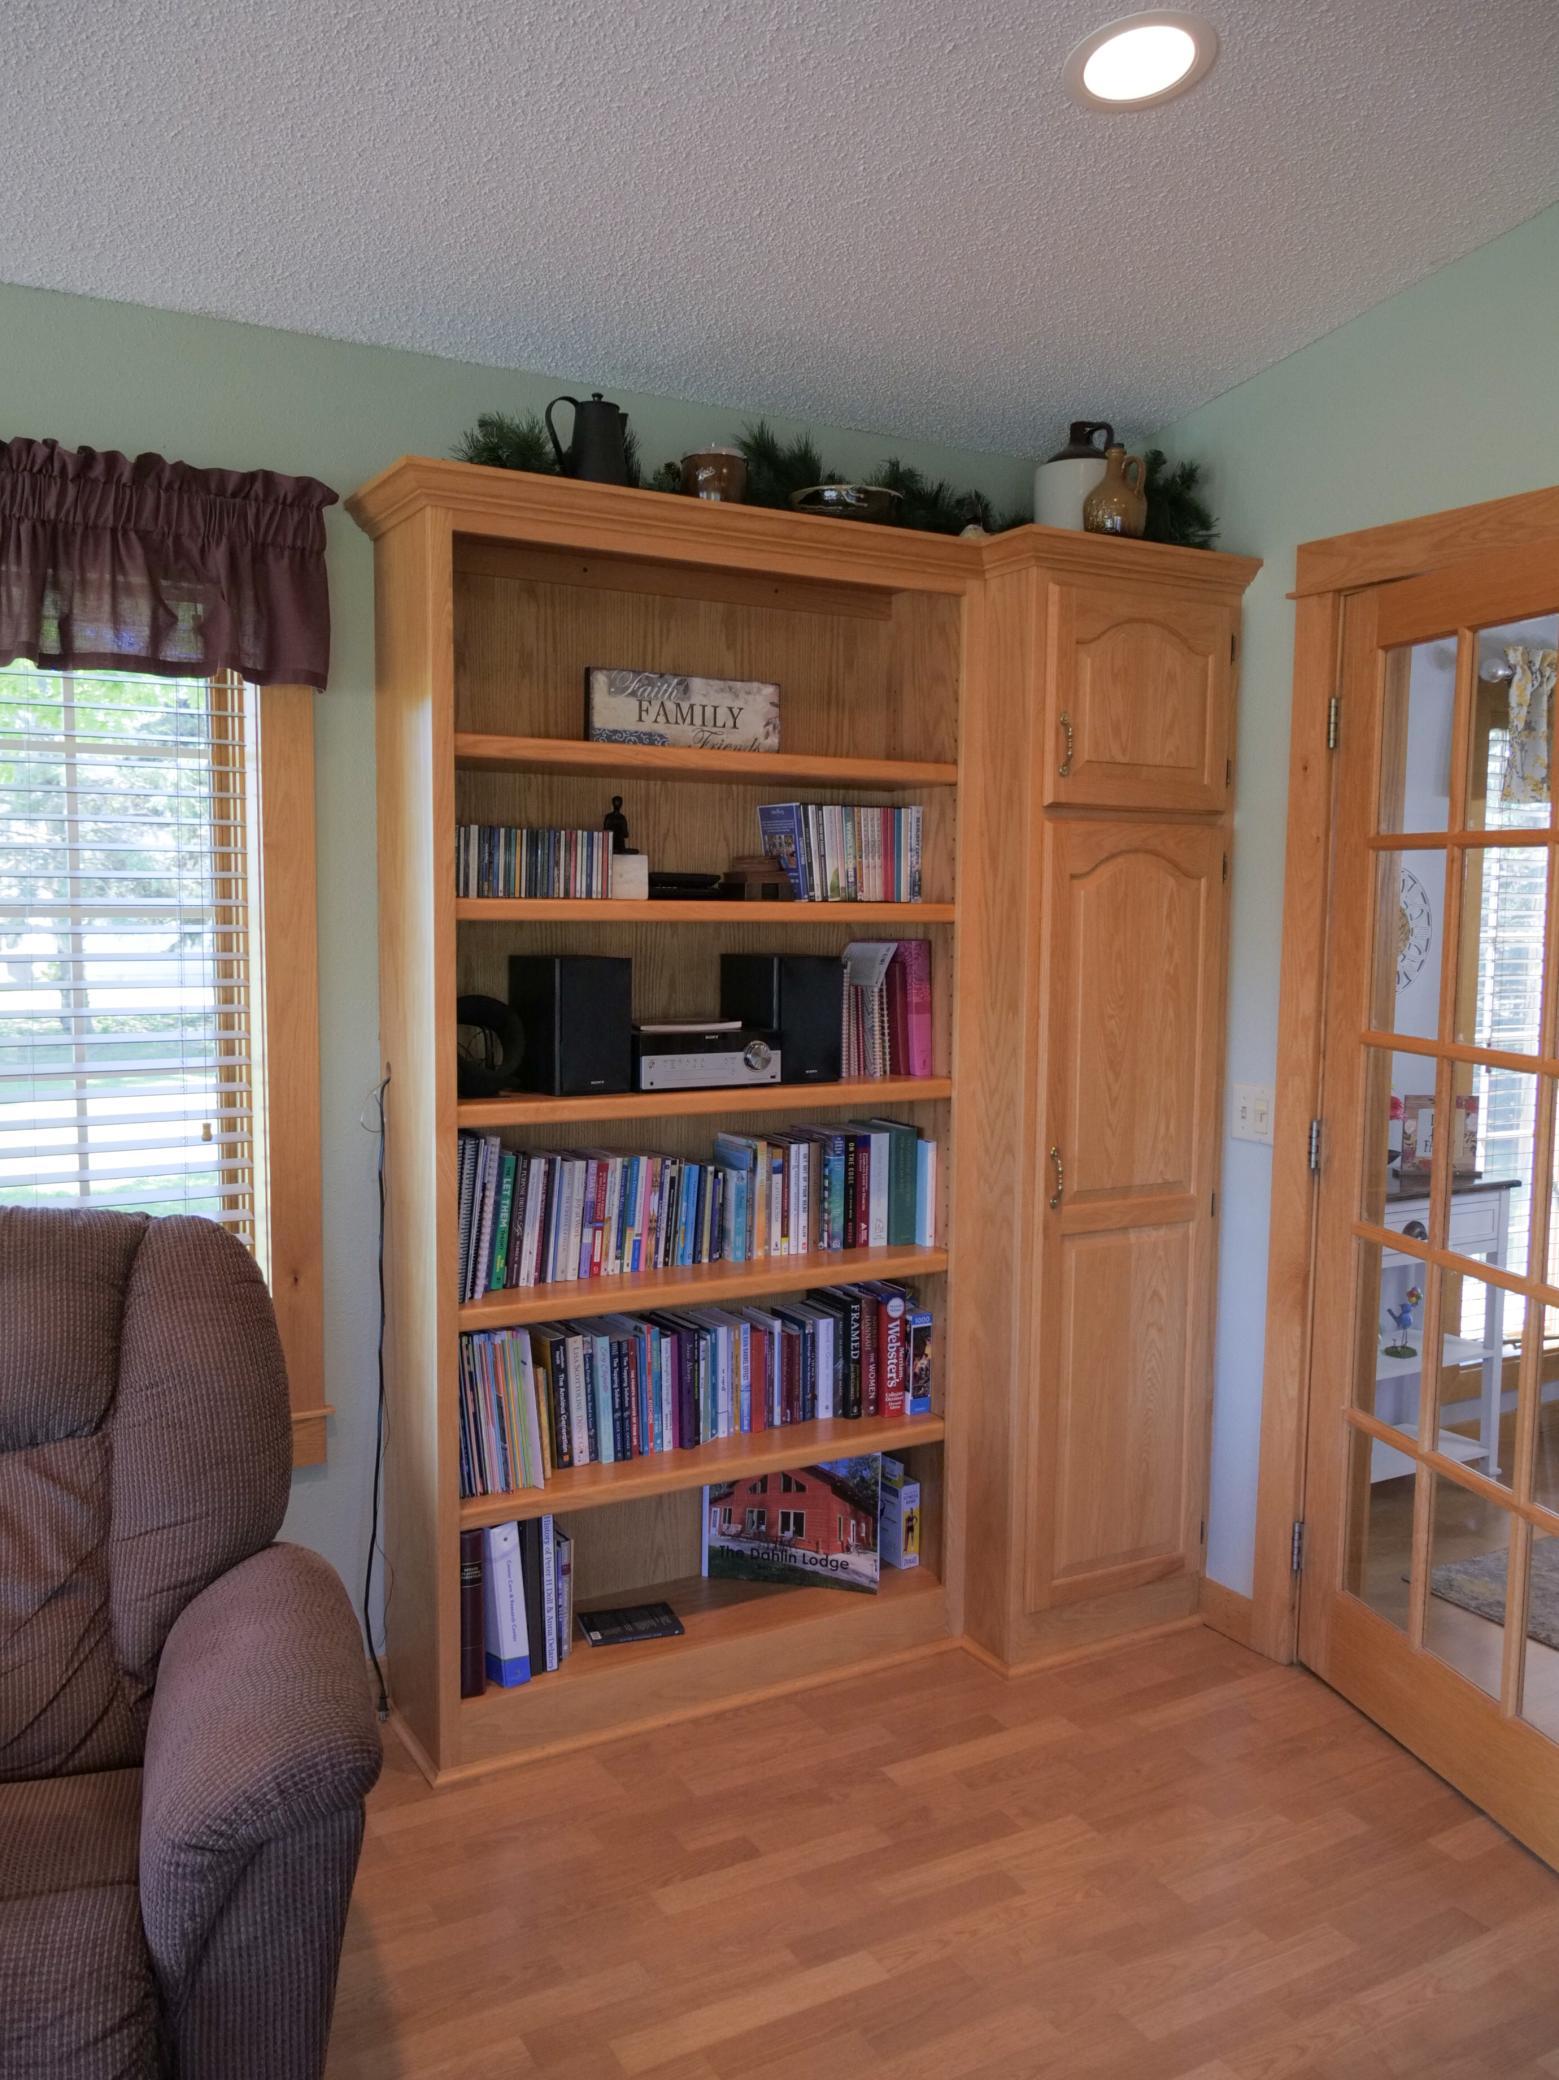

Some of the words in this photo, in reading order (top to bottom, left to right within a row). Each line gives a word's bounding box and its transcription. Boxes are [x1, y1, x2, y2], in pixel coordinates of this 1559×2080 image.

[610, 671, 681, 702] Faith
[636, 699, 745, 730] FAMILY
[502, 1177, 512, 1196] LET
[500, 1199, 510, 1228] THEM
[851, 1304, 861, 1359] FRAMED
[864, 1315, 872, 1351] HANNAH
[887, 1319, 901, 1388] Webster's
[868, 1363, 876, 1399] WOMEN
[719, 1545, 745, 1560] The
[750, 1547, 798, 1564] Dahlin
[802, 1553, 850, 1572] Lodge
